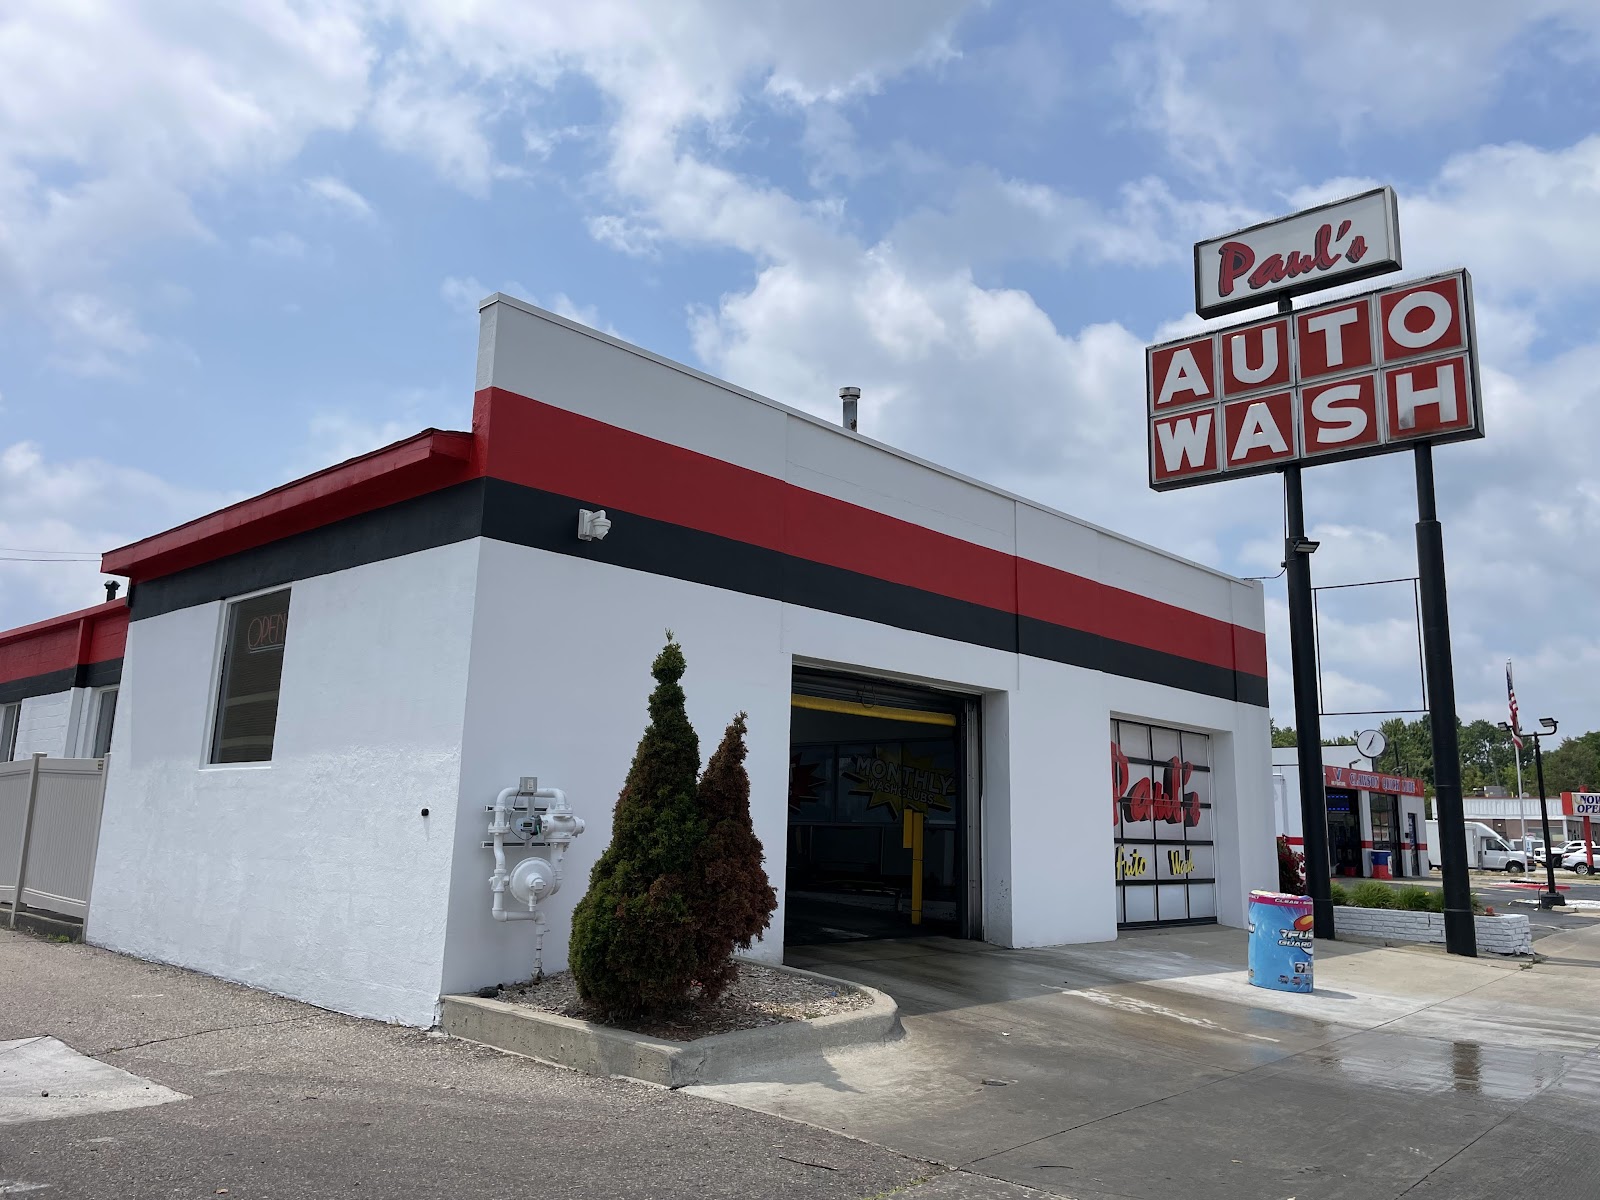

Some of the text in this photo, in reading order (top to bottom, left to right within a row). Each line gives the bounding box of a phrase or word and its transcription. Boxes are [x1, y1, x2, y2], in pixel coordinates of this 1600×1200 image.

[1218, 219, 1369, 298] Paul's
[1157, 290, 1453, 405] AUTO
[1155, 364, 1458, 473] WASH
[248, 614, 287, 647] OPEN
[855, 755, 955, 796] MONTHLY
[868, 778, 935, 805] WASH CLUBS
[1577, 804, 1600, 814] OPE
[1115, 845, 1147, 880] Auto
